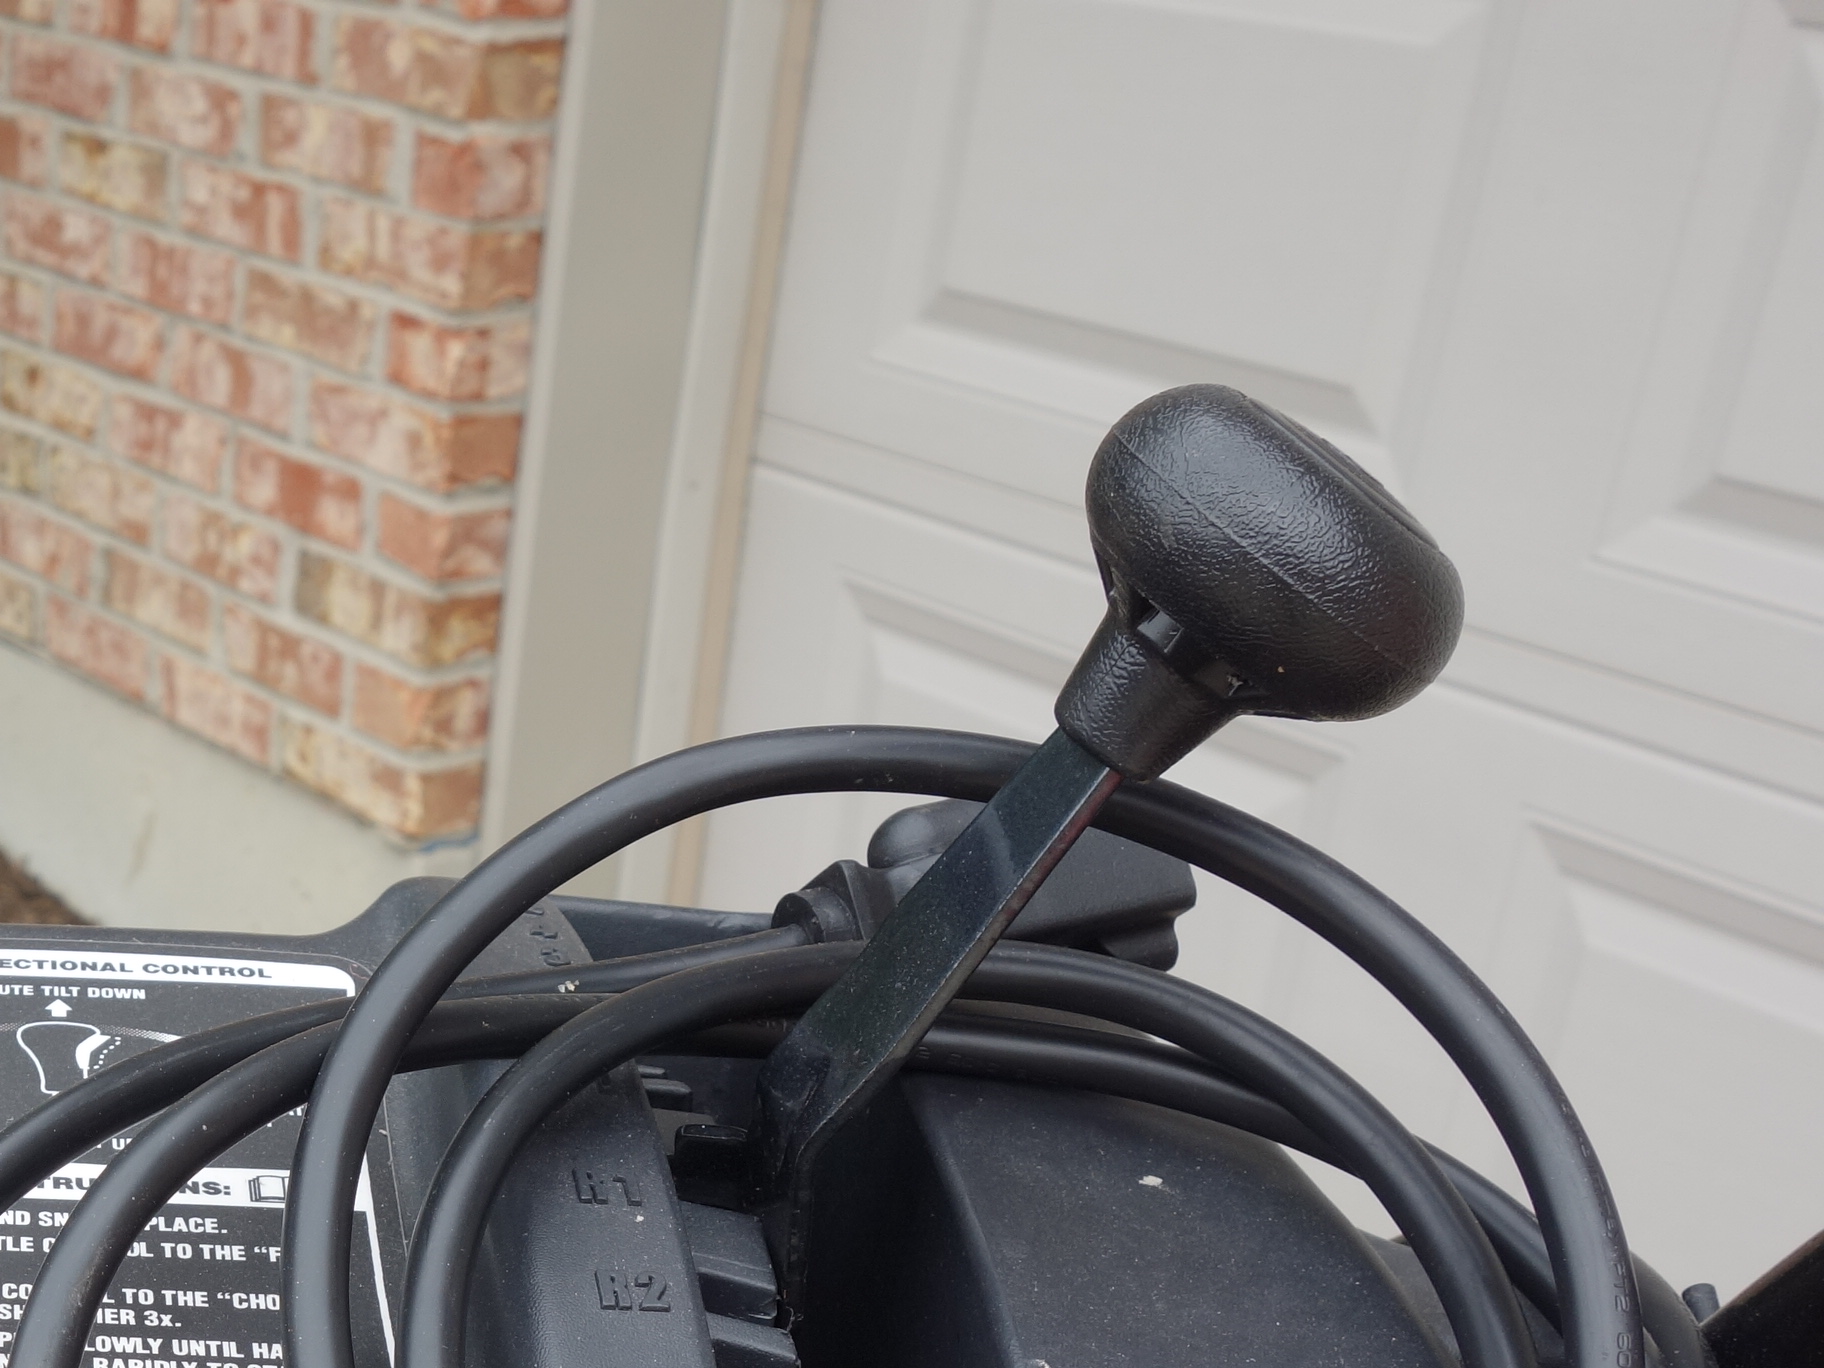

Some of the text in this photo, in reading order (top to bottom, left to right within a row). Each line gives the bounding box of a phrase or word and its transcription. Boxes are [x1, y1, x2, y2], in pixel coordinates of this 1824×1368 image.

[142, 962, 273, 979] CONTROL
[40, 985, 82, 998] TILT
[87, 986, 146, 1000] DOWN
[38, 1210, 70, 1228] SN
[160, 1241, 193, 1260] TO
[199, 1243, 246, 1262] THE
[122, 1287, 155, 1306] TO
[161, 1289, 210, 1308] THE
[217, 1292, 281, 1311] “CHO
[594, 1269, 672, 1313] R2
[143, 1311, 182, 1328] 3x.
[171, 1338, 244, 1359] UNTIL
